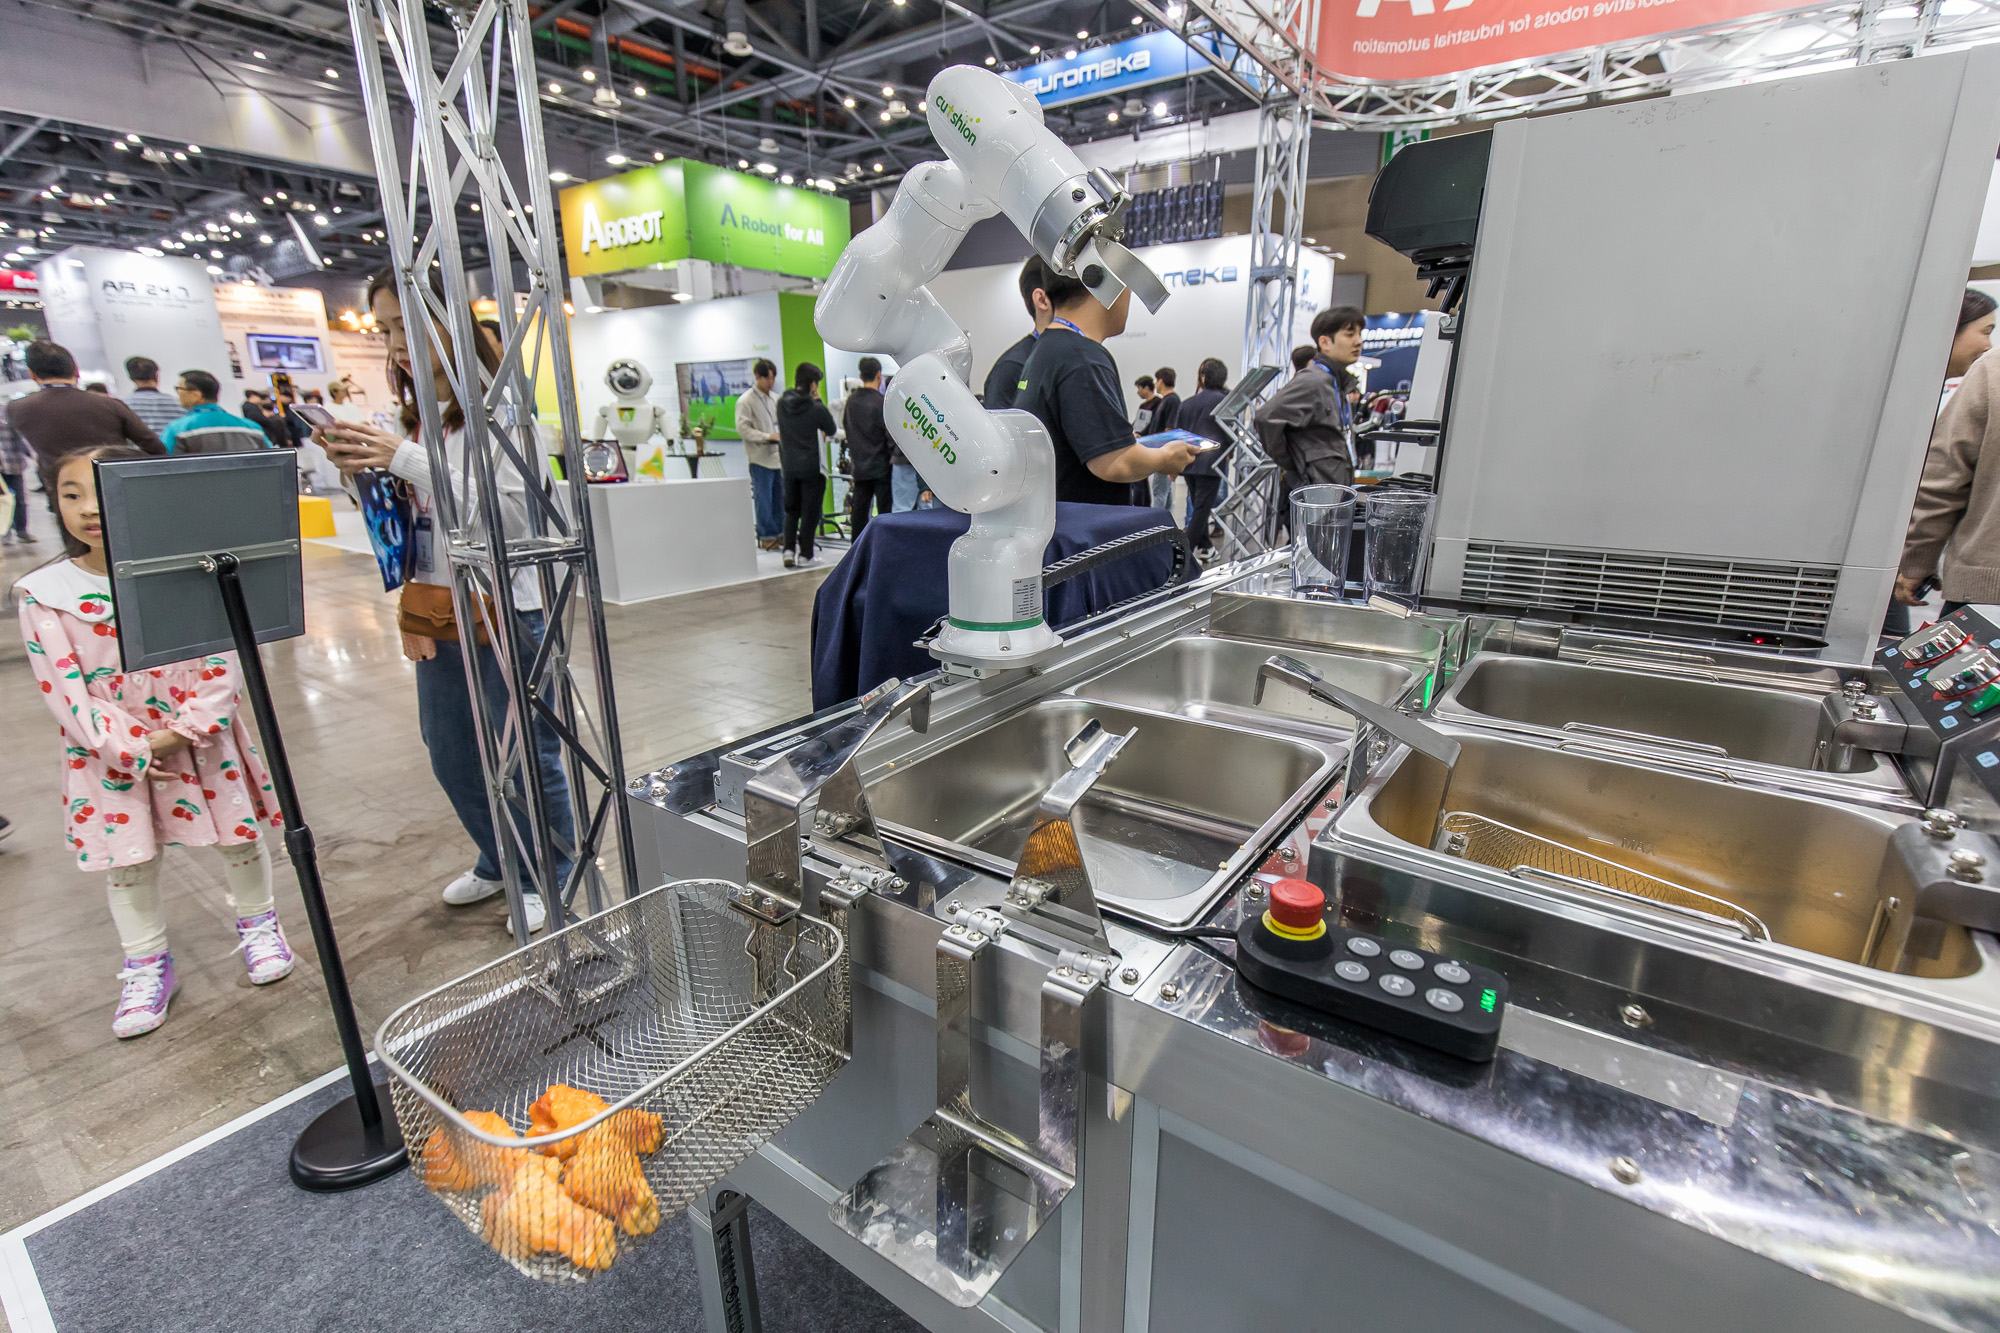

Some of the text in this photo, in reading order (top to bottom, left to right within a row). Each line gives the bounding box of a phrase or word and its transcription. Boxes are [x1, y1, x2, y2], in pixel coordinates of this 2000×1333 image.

[1019, 50, 1151, 94] euromeka
[935, 95, 977, 147] cutshion
[581, 202, 664, 253] AROBOT
[741, 215, 783, 237] Robot
[783, 222, 804, 242] for
[806, 227, 824, 247] All
[904, 397, 957, 464] cutshion
[1621, 837, 1656, 857] MAX
